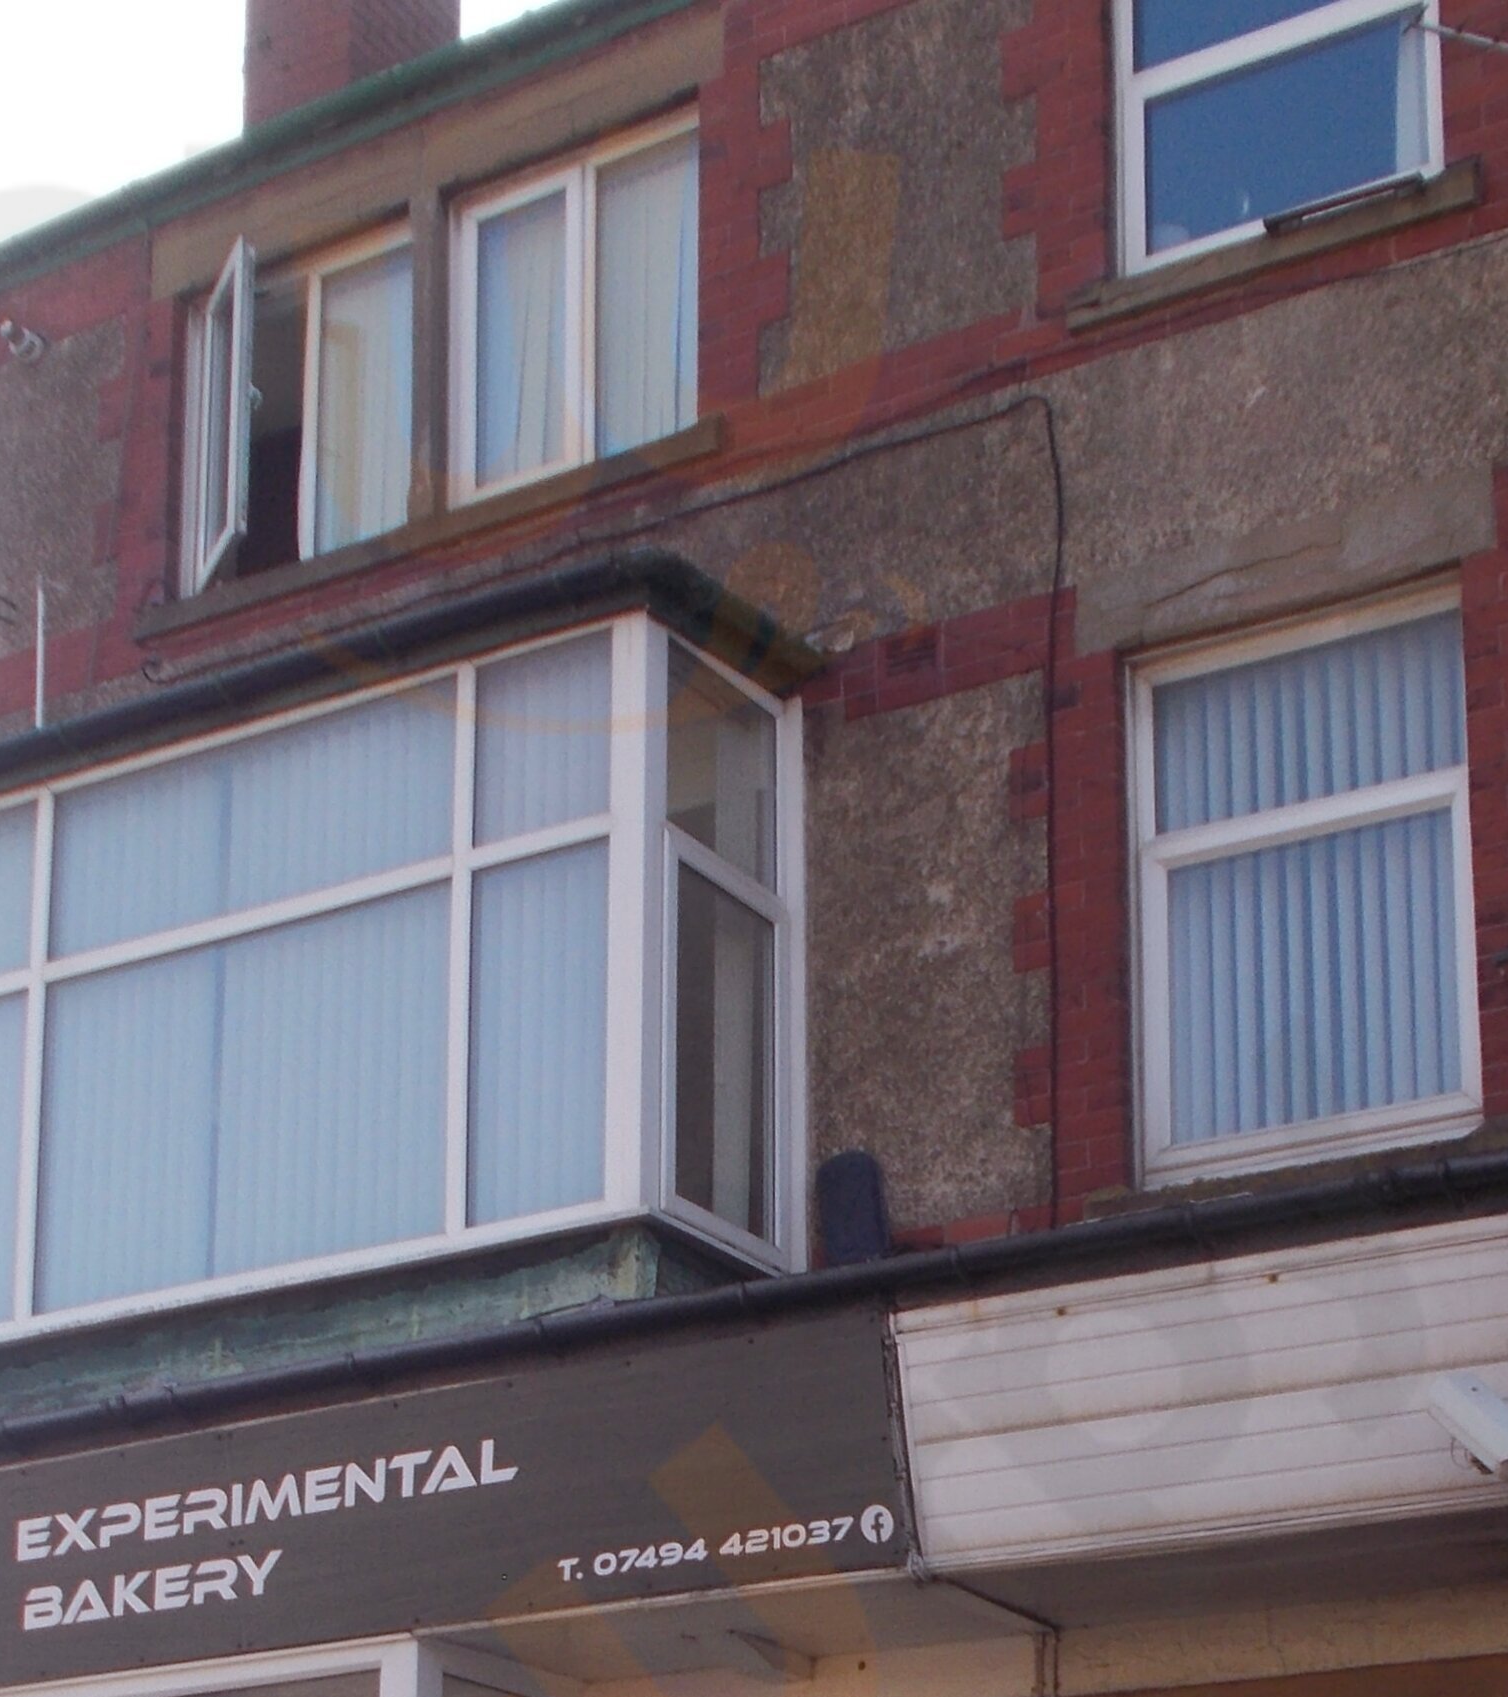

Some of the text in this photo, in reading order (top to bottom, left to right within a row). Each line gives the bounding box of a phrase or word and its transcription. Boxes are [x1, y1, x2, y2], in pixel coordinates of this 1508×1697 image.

[16, 1438, 519, 1562] EXPERIMENTAL
[23, 1549, 283, 1631] BAKERY
[557, 1557, 584, 1582] T.
[593, 1538, 709, 1576] 07494
[718, 1516, 855, 1556] 421037
